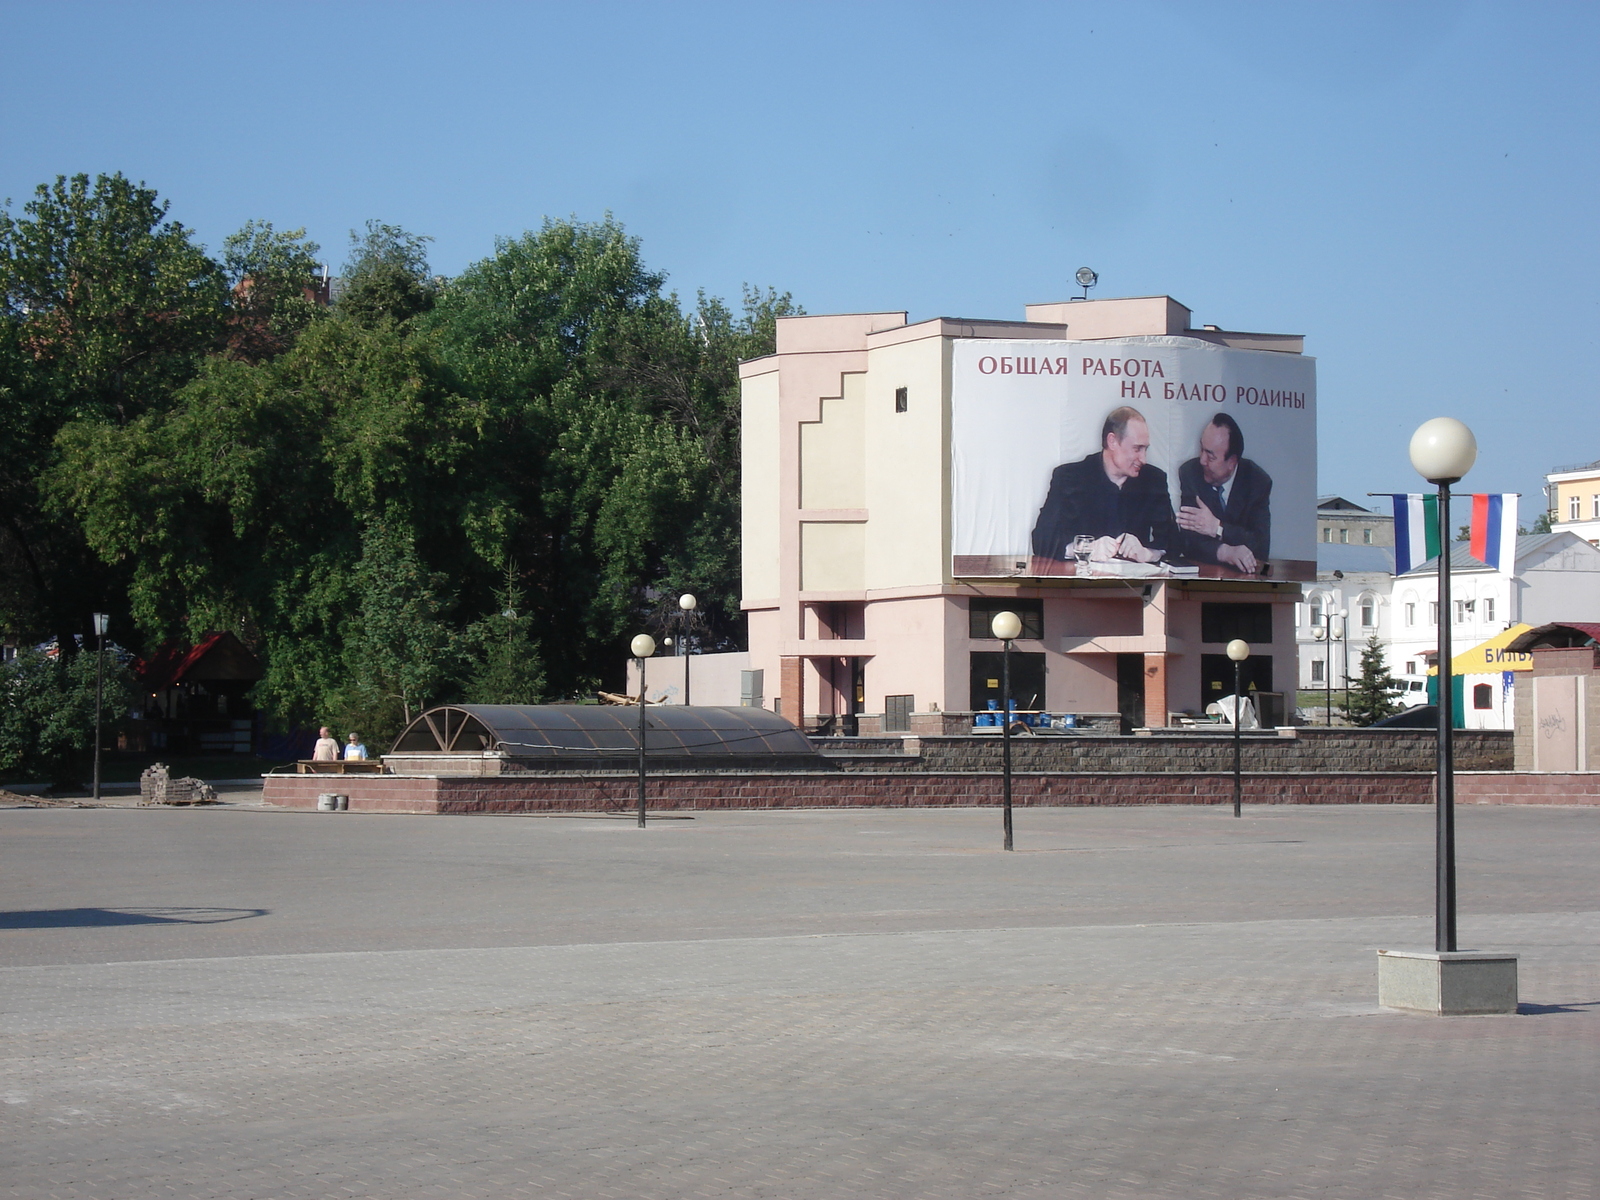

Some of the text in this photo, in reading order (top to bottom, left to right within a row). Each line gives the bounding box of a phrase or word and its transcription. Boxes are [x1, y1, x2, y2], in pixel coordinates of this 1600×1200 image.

[978, 356, 1165, 378] ОБЩАЯ РАБОТА
[1121, 380, 1305, 409] НА БЛАГО РОДИНЫ
